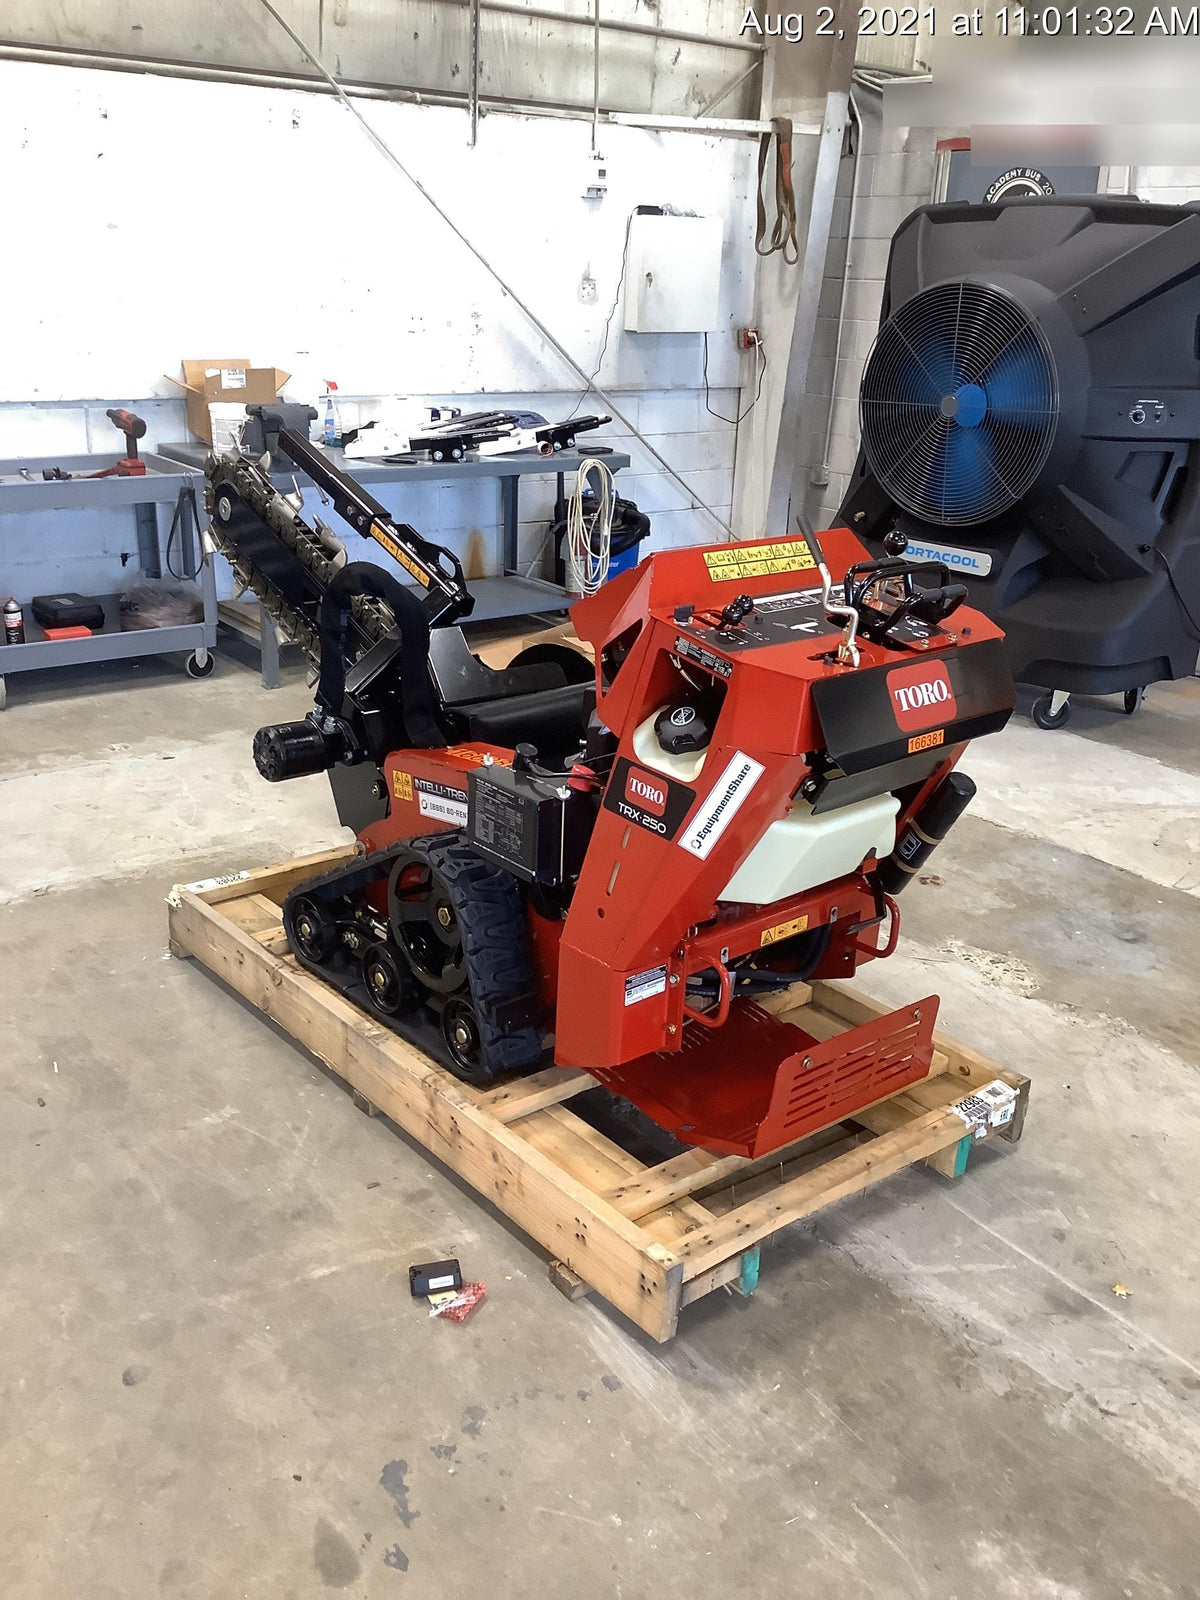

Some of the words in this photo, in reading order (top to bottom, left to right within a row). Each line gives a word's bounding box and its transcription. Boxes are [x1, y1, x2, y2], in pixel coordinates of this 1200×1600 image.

[986, 168, 1023, 202] ACADEMY
[1025, 168, 1041, 182] BUS
[905, 545, 980, 569] ORTACOOL
[894, 679, 949, 712] TORO
[909, 731, 944, 751] 166381
[629, 777, 664, 805] TORO
[697, 764, 752, 841] EquipmentShare
[955, 1095, 985, 1113] 22983
